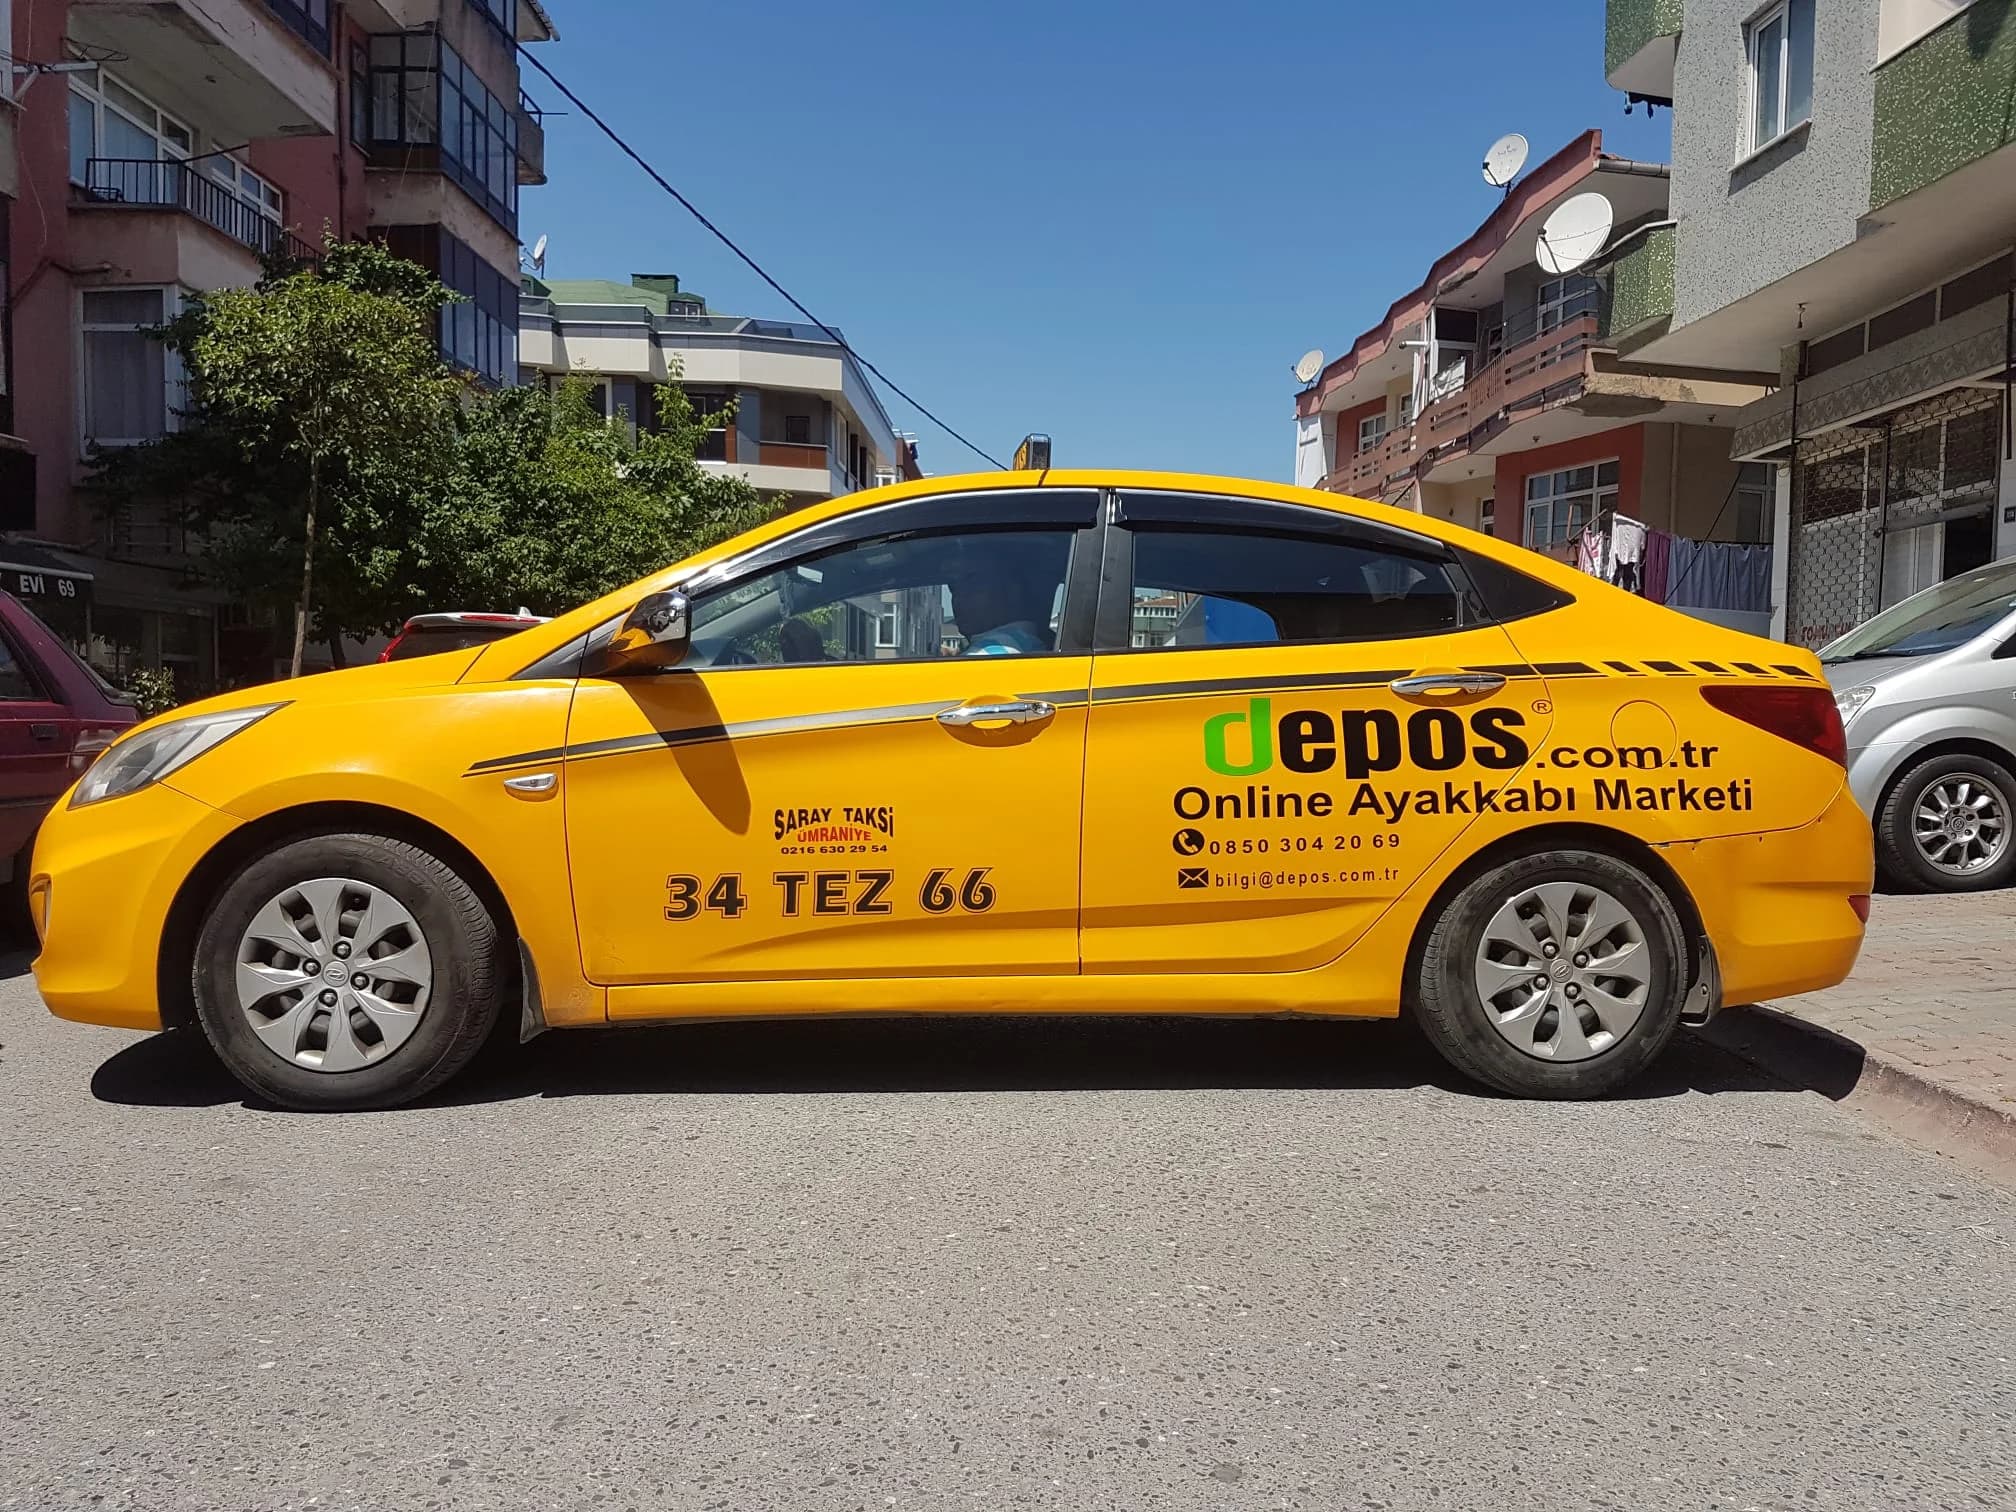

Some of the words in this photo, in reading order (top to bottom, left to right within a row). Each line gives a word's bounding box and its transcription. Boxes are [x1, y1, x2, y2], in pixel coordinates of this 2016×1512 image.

[19, 574, 46, 594] EVİ
[57, 578, 76, 598] 69
[1204, 698, 1529, 779] depos
[1173, 785, 1333, 821] Online
[1347, 779, 1576, 824] Ayakkabı
[1593, 778, 1752, 812] Marketi
[774, 807, 833, 841] SARAY
[780, 846, 816, 855] 0216
[819, 845, 846, 854] 630
[849, 845, 867, 853] 29
[871, 844, 888, 853] 54
[1209, 838, 1270, 855] 0850
[1279, 836, 1324, 853] 304
[1334, 835, 1362, 850] 20
[1372, 833, 1400, 849] 69
[1215, 867, 1399, 890] bilgi@depos.com.tr
[664, 873, 748, 922] 34
[772, 868, 895, 918] TEZ
[918, 866, 998, 914] 66
